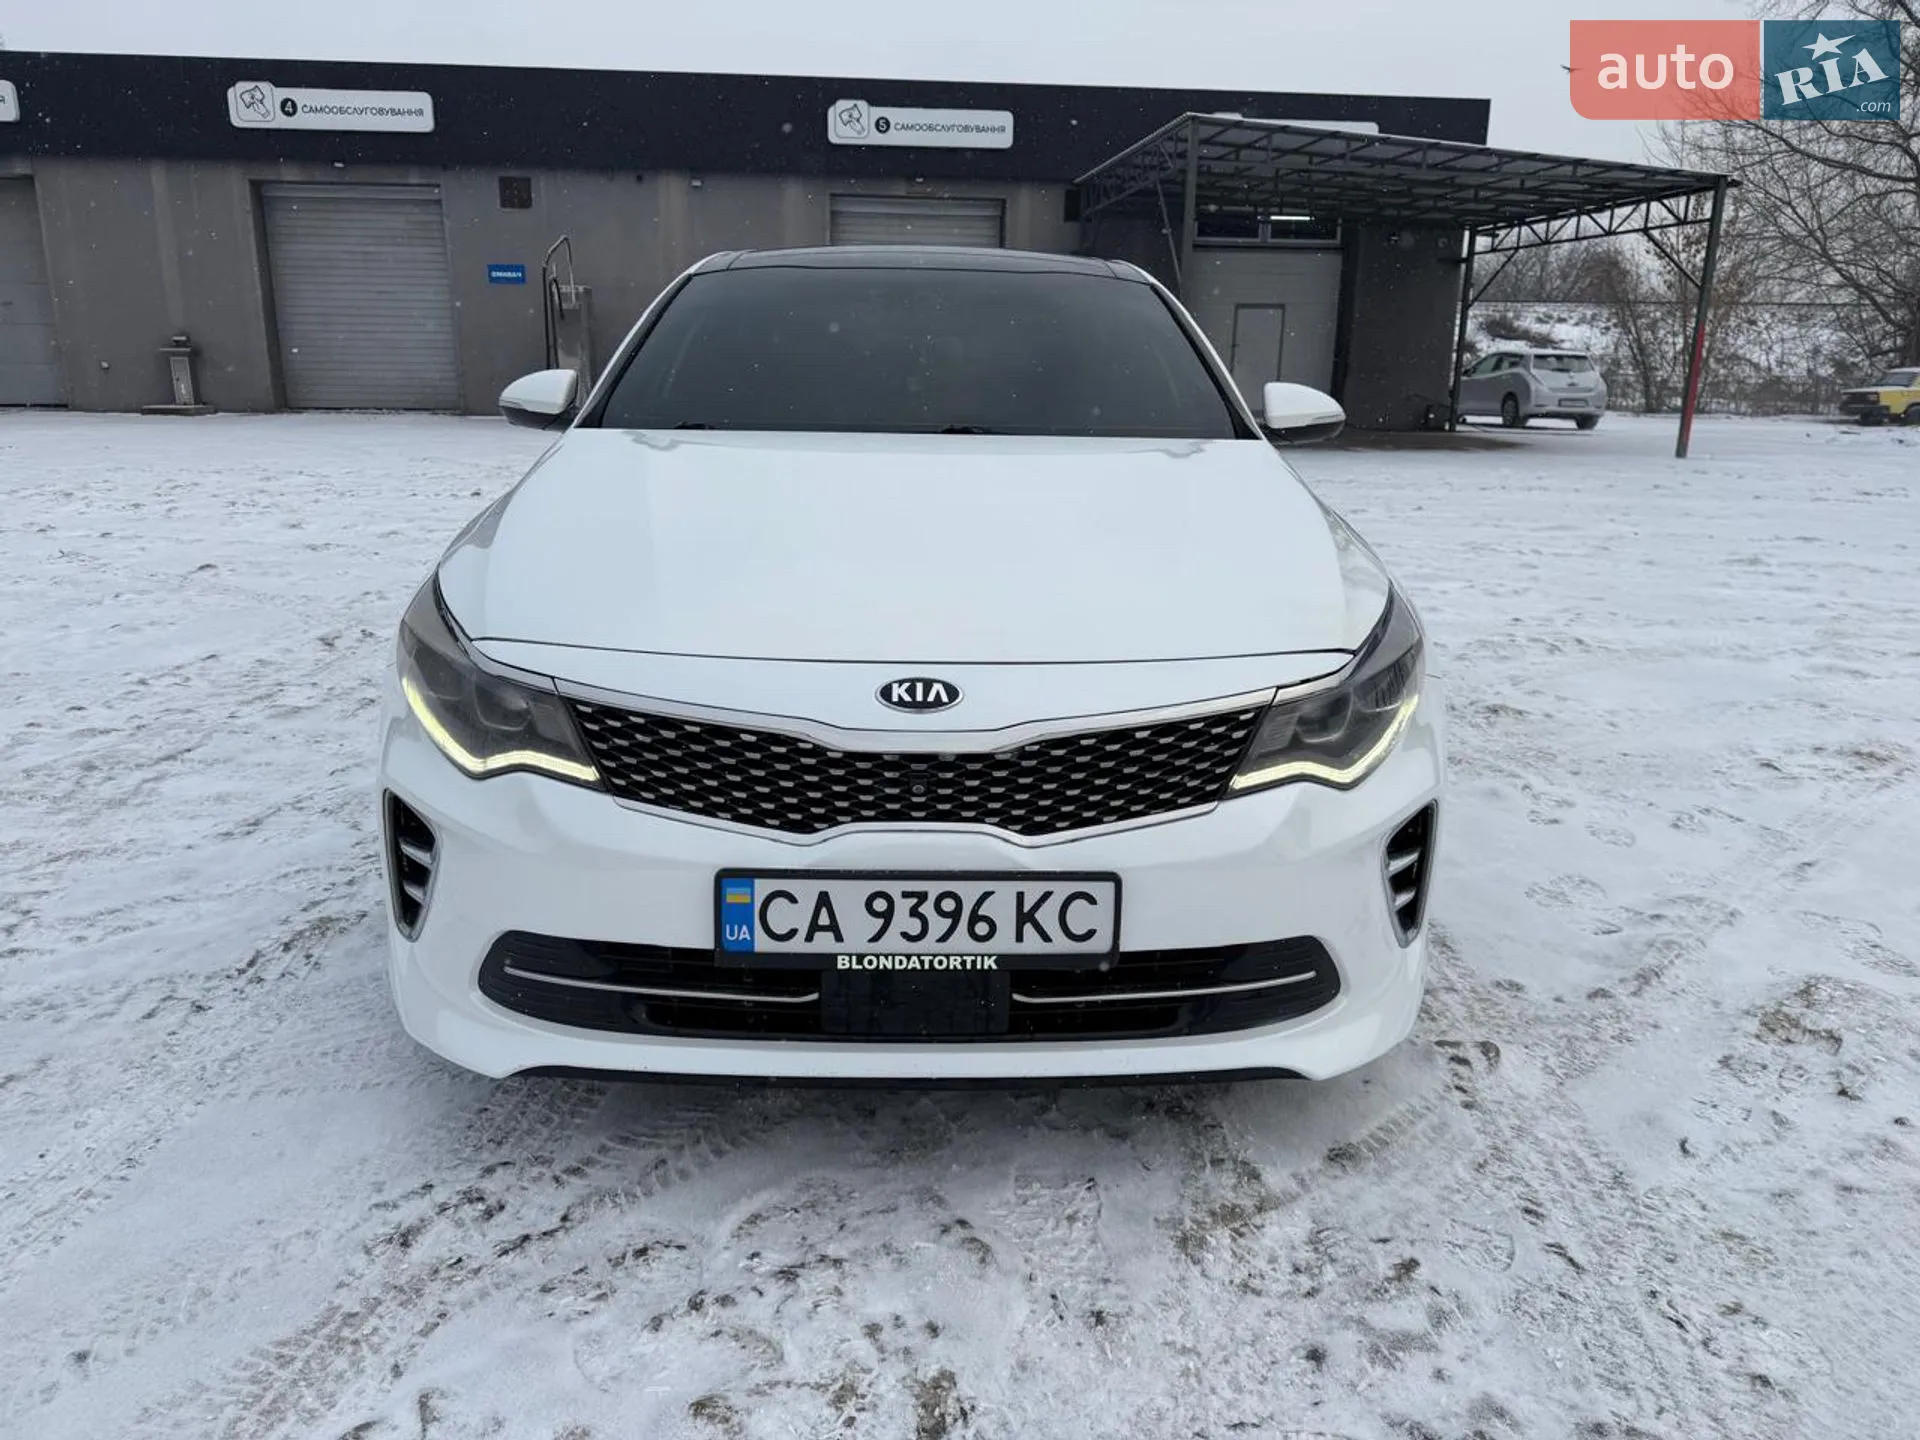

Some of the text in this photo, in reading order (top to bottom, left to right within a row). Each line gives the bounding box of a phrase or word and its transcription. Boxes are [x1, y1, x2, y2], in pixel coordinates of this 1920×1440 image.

[301, 104, 424, 117] САМООБСЛУГОВУВАННЯ
[893, 122, 1006, 133] САМООБСЛУГОВУВАННЯ
[891, 682, 949, 702] KIA
[758, 889, 1098, 944] CA 9396 KC
[725, 925, 751, 941] UA
[837, 955, 998, 970] BLONDATORTIK
